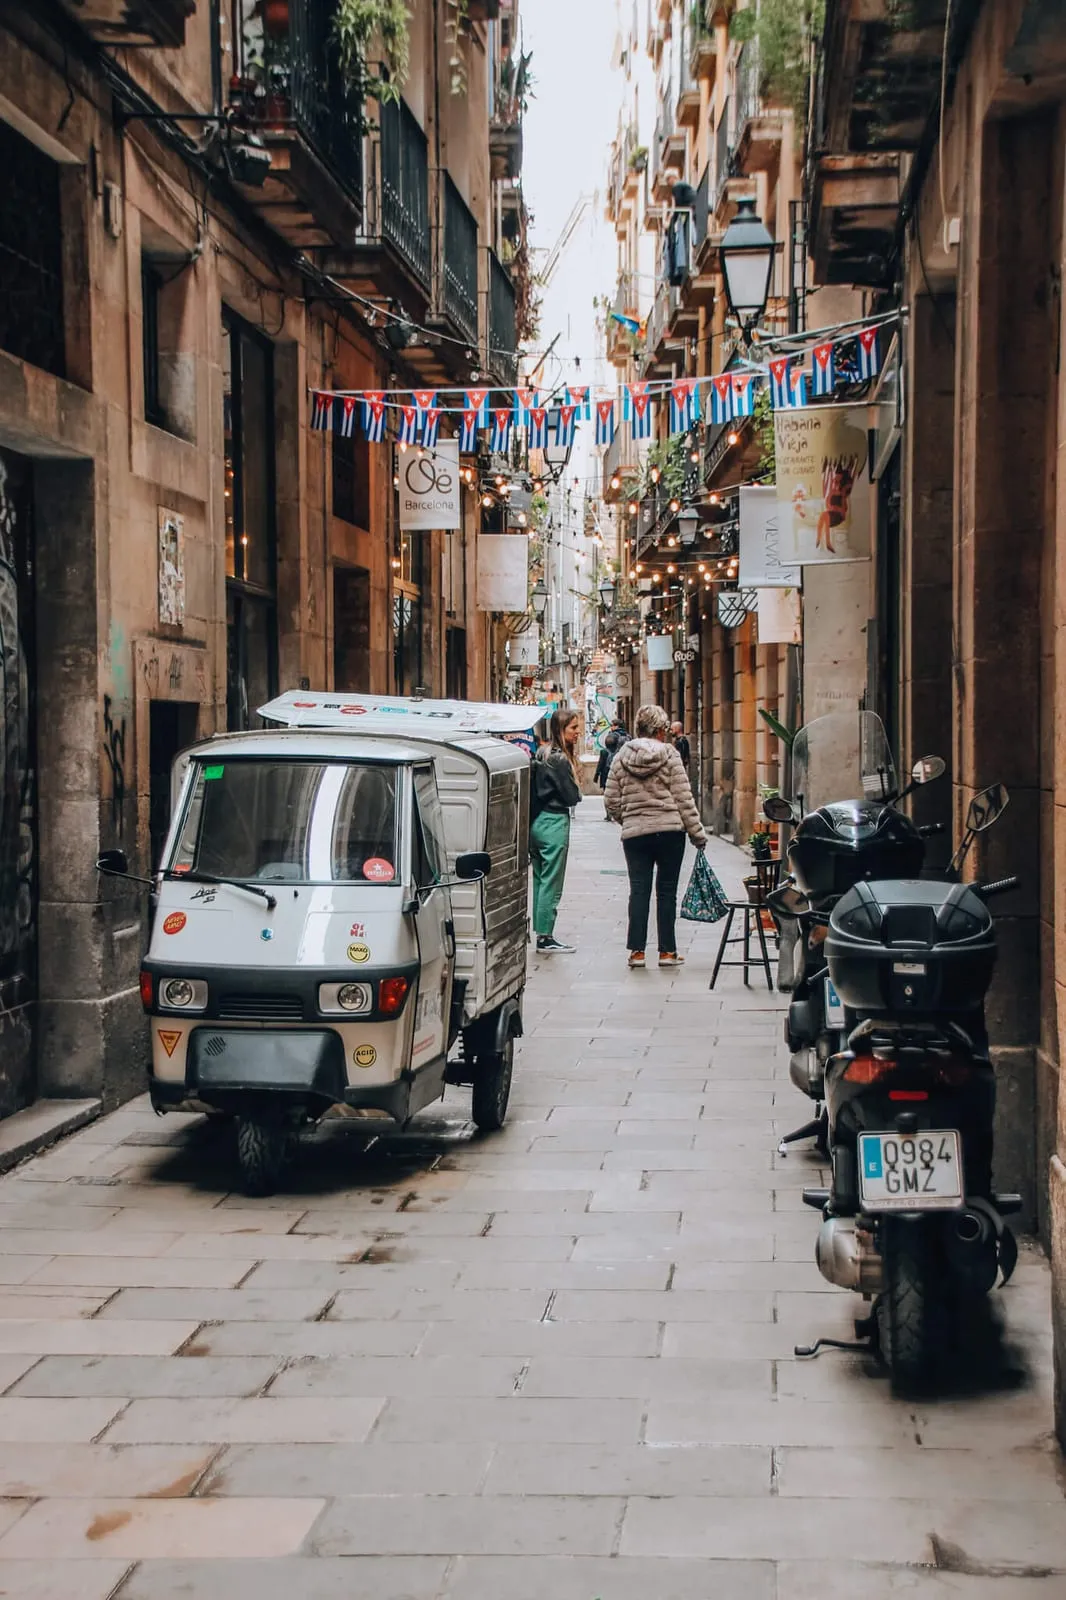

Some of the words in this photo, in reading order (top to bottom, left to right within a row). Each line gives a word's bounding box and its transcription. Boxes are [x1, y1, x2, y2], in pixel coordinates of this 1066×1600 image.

[776, 416, 821, 432] Habana
[405, 499, 453, 510] Barcelona
[884, 1138, 952, 1164] 0984
[869, 1162, 877, 1171] E
[886, 1167, 936, 1193] GMZ
